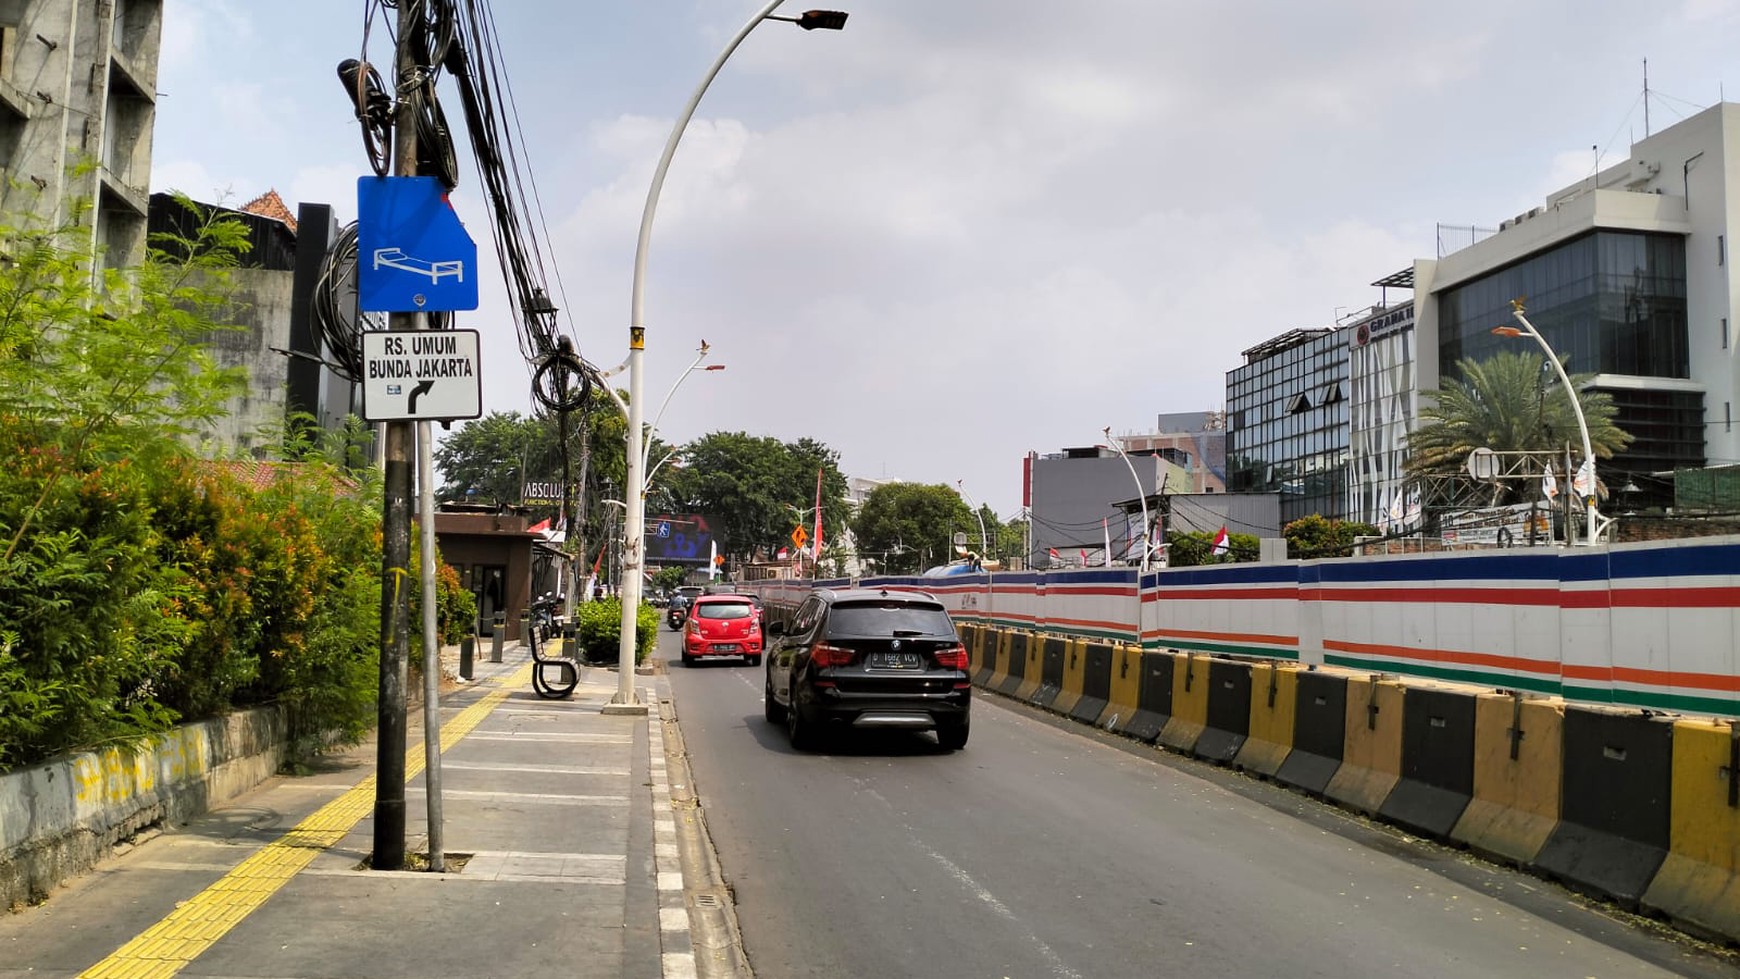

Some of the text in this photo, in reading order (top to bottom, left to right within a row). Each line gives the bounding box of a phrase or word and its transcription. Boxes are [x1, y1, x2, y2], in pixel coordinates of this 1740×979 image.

[385, 336, 457, 356] RS. UMUM
[369, 358, 473, 379] BUNDA JAKARTA
